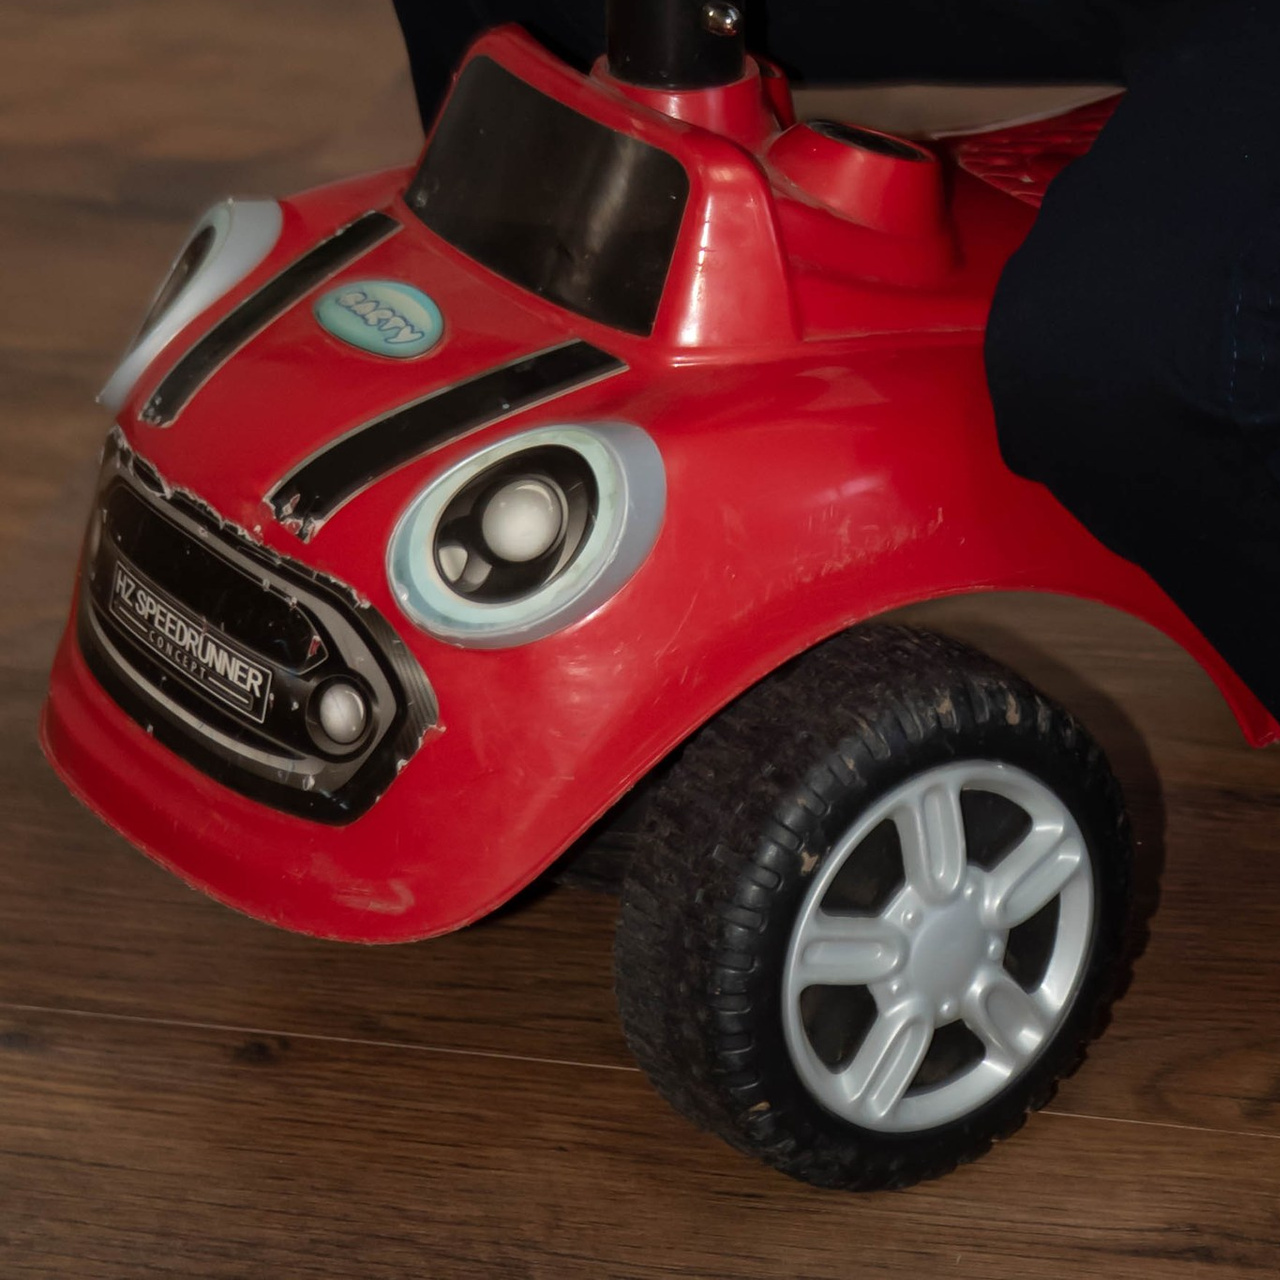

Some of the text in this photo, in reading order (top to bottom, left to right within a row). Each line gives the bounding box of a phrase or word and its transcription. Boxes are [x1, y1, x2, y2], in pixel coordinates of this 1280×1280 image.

[115, 569, 263, 698] HZ SPEEDRUNNER
[149, 630, 206, 679] CONCEPT
